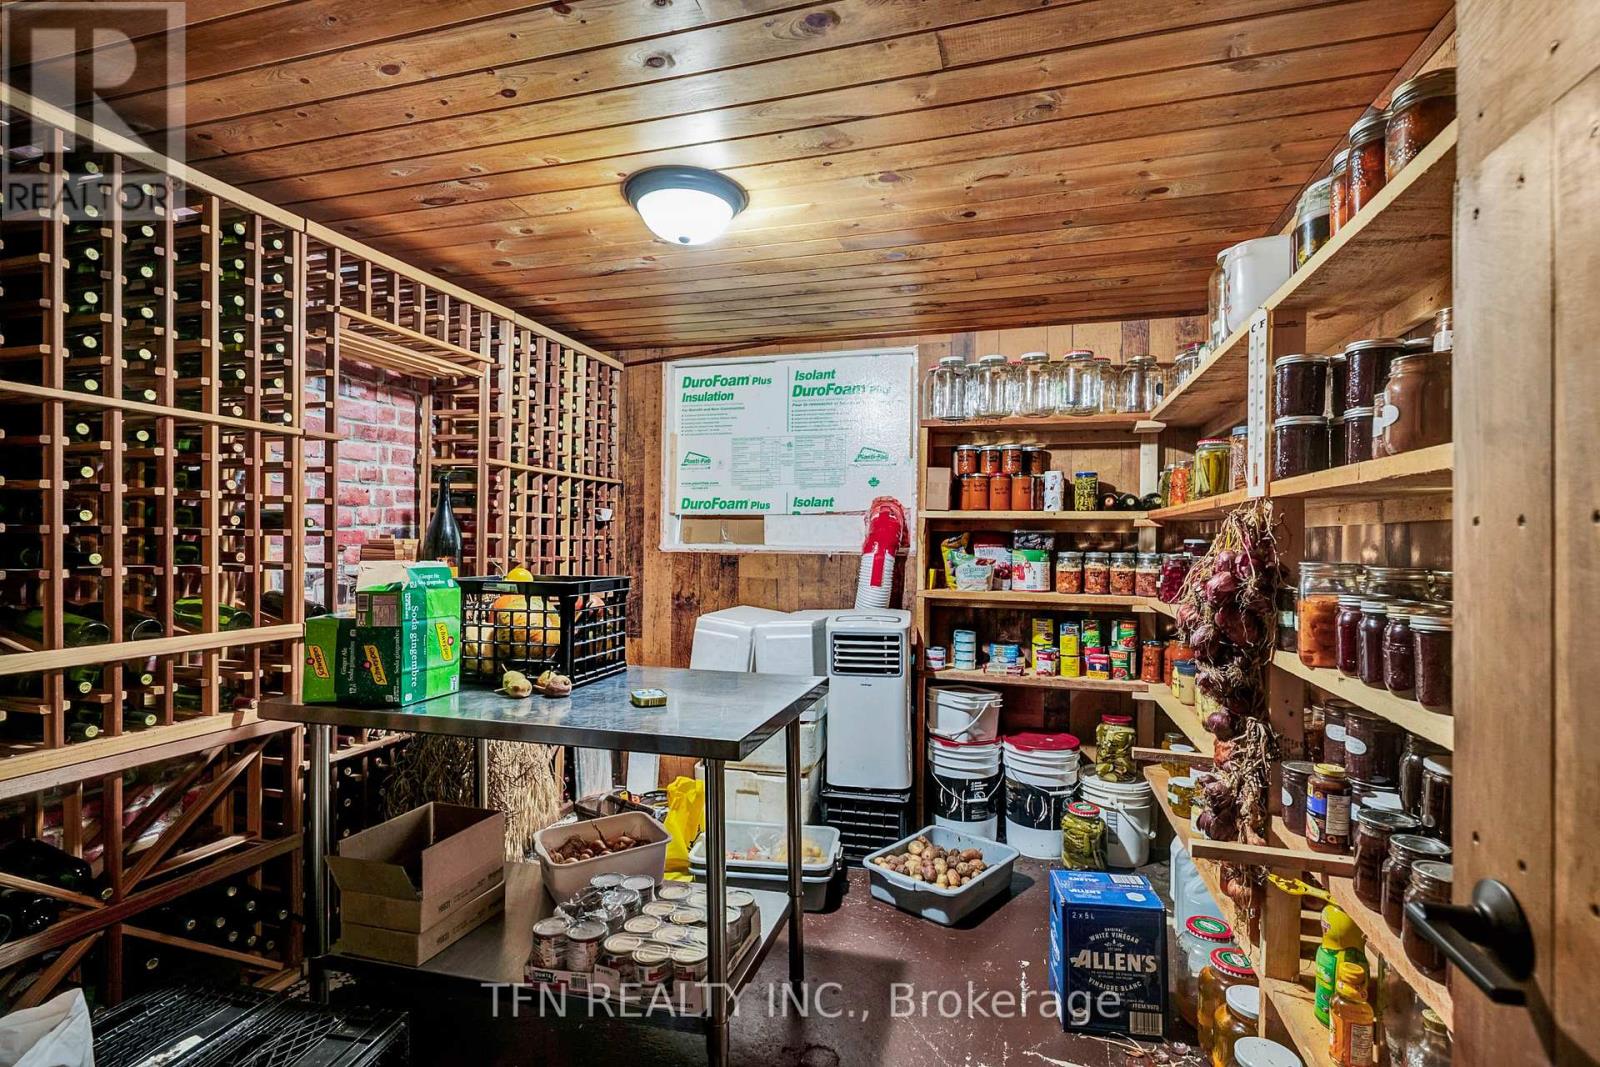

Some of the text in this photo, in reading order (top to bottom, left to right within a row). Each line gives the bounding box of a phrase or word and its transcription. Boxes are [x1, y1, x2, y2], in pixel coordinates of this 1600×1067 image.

[682, 375, 772, 389] DuroFoam Plus
[795, 369, 836, 382] Isolant
[682, 391, 734, 403] Insulation
[792, 383, 866, 398] DuroFoam
[681, 498, 771, 511] DuroFoam Plus
[793, 497, 834, 508] Isolant
[409, 605, 420, 688] Soda gingembre
[312, 647, 327, 677] Schweppes
[368, 647, 386, 684] Schweppes
[1089, 932, 1139, 945] WHITE VINEGAR
[1070, 949, 1157, 974] ALLEN'S
[1088, 977, 1143, 993] VINAIGRE BLANC
